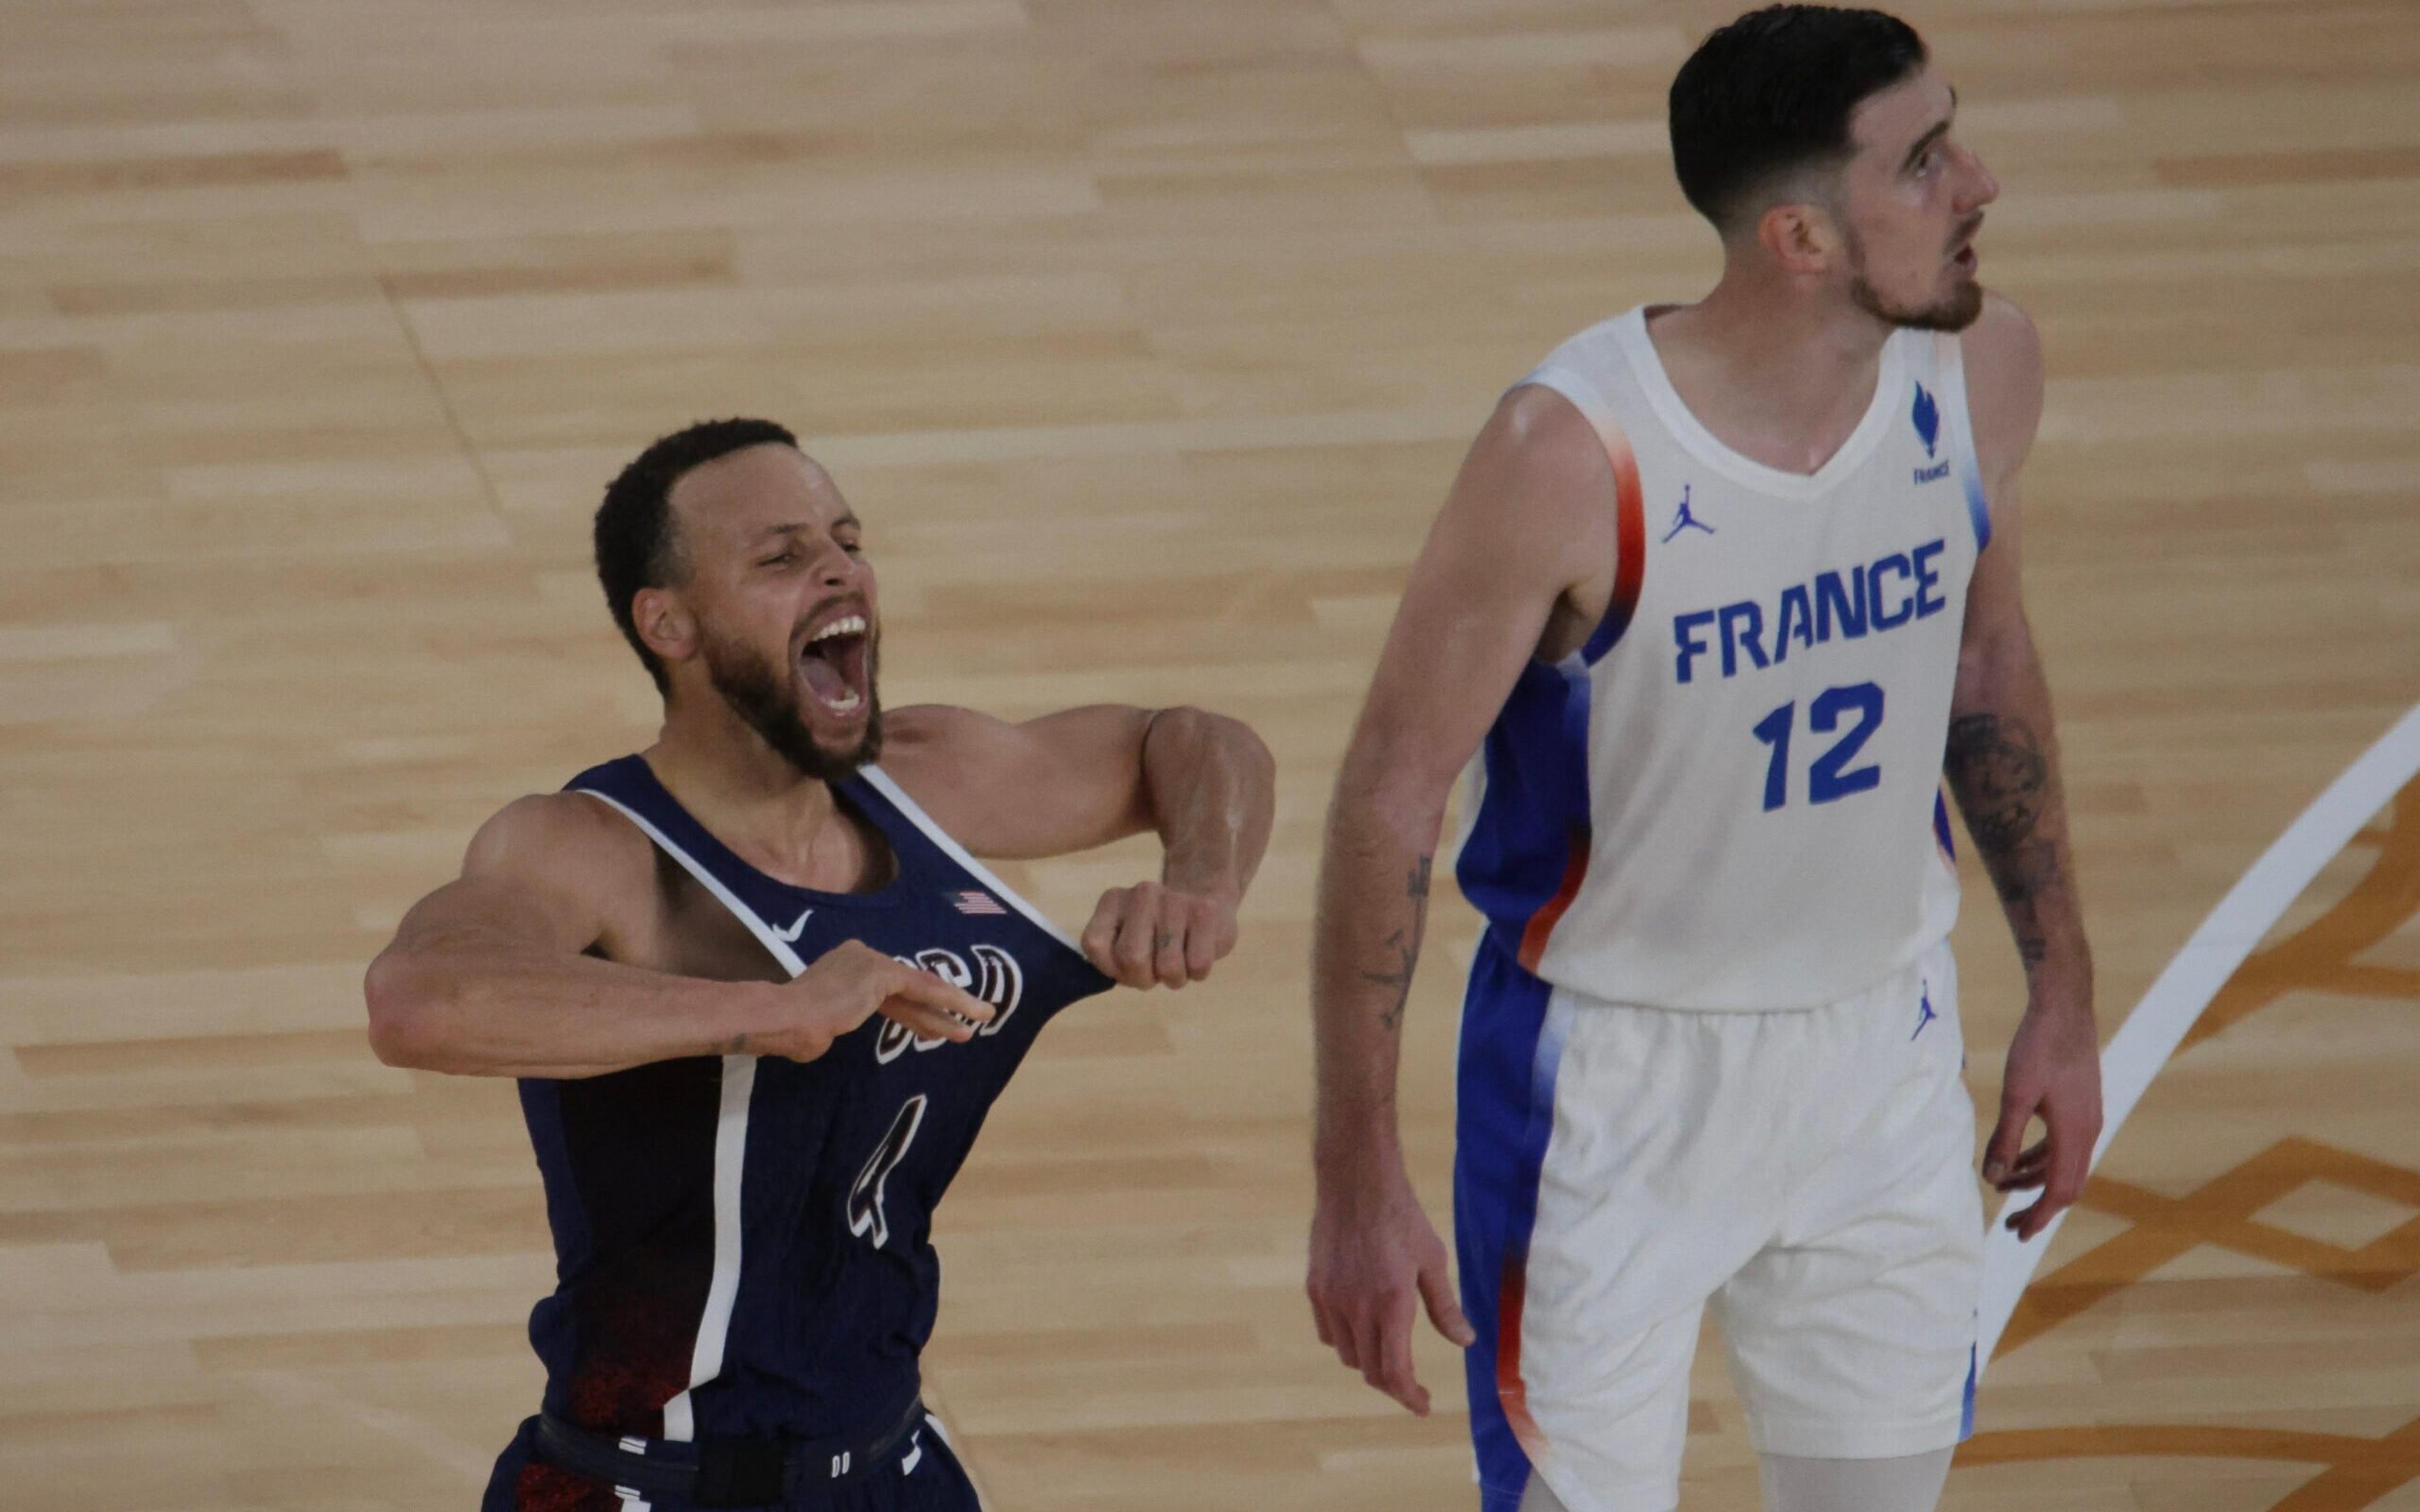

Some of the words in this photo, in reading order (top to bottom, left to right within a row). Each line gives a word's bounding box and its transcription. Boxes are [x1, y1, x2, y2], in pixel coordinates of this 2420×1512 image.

[1673, 539, 1946, 684] FRANCE
[1752, 680, 1885, 813] 12
[847, 1093, 928, 1250] 4
